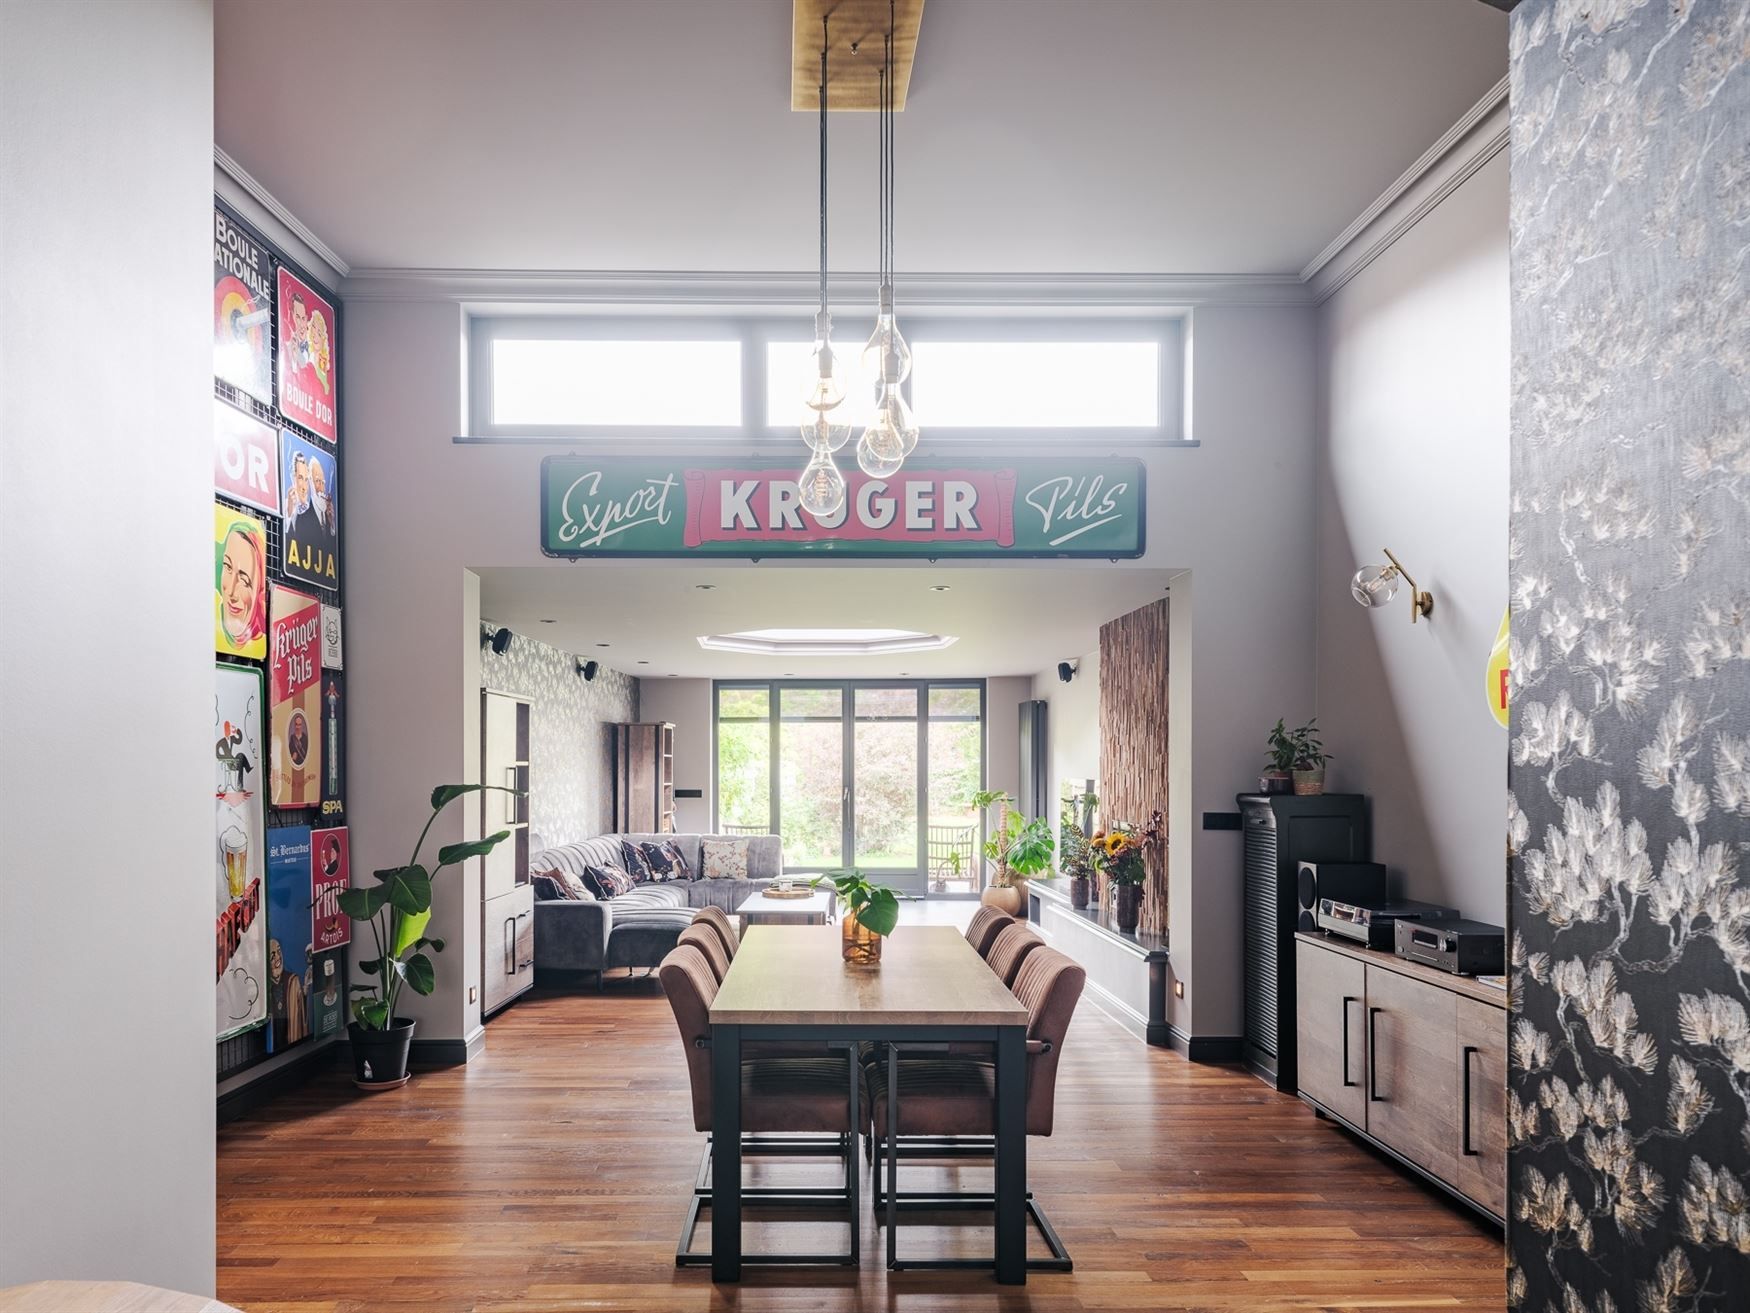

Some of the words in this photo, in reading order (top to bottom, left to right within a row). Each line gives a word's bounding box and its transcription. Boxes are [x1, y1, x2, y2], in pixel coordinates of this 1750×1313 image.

[215, 214, 259, 270] BOULE
[214, 242, 270, 300] ATIONALE
[286, 384, 313, 415] BOULE
[316, 402, 333, 427] D'OR
[558, 471, 680, 548] Export
[1025, 474, 1128, 534] Pils
[287, 539, 336, 579] AJJA
[273, 616, 318, 669] Krüger
[287, 653, 313, 695] Pils
[322, 800, 343, 815] SPA
[320, 927, 343, 944] ARTOIS
